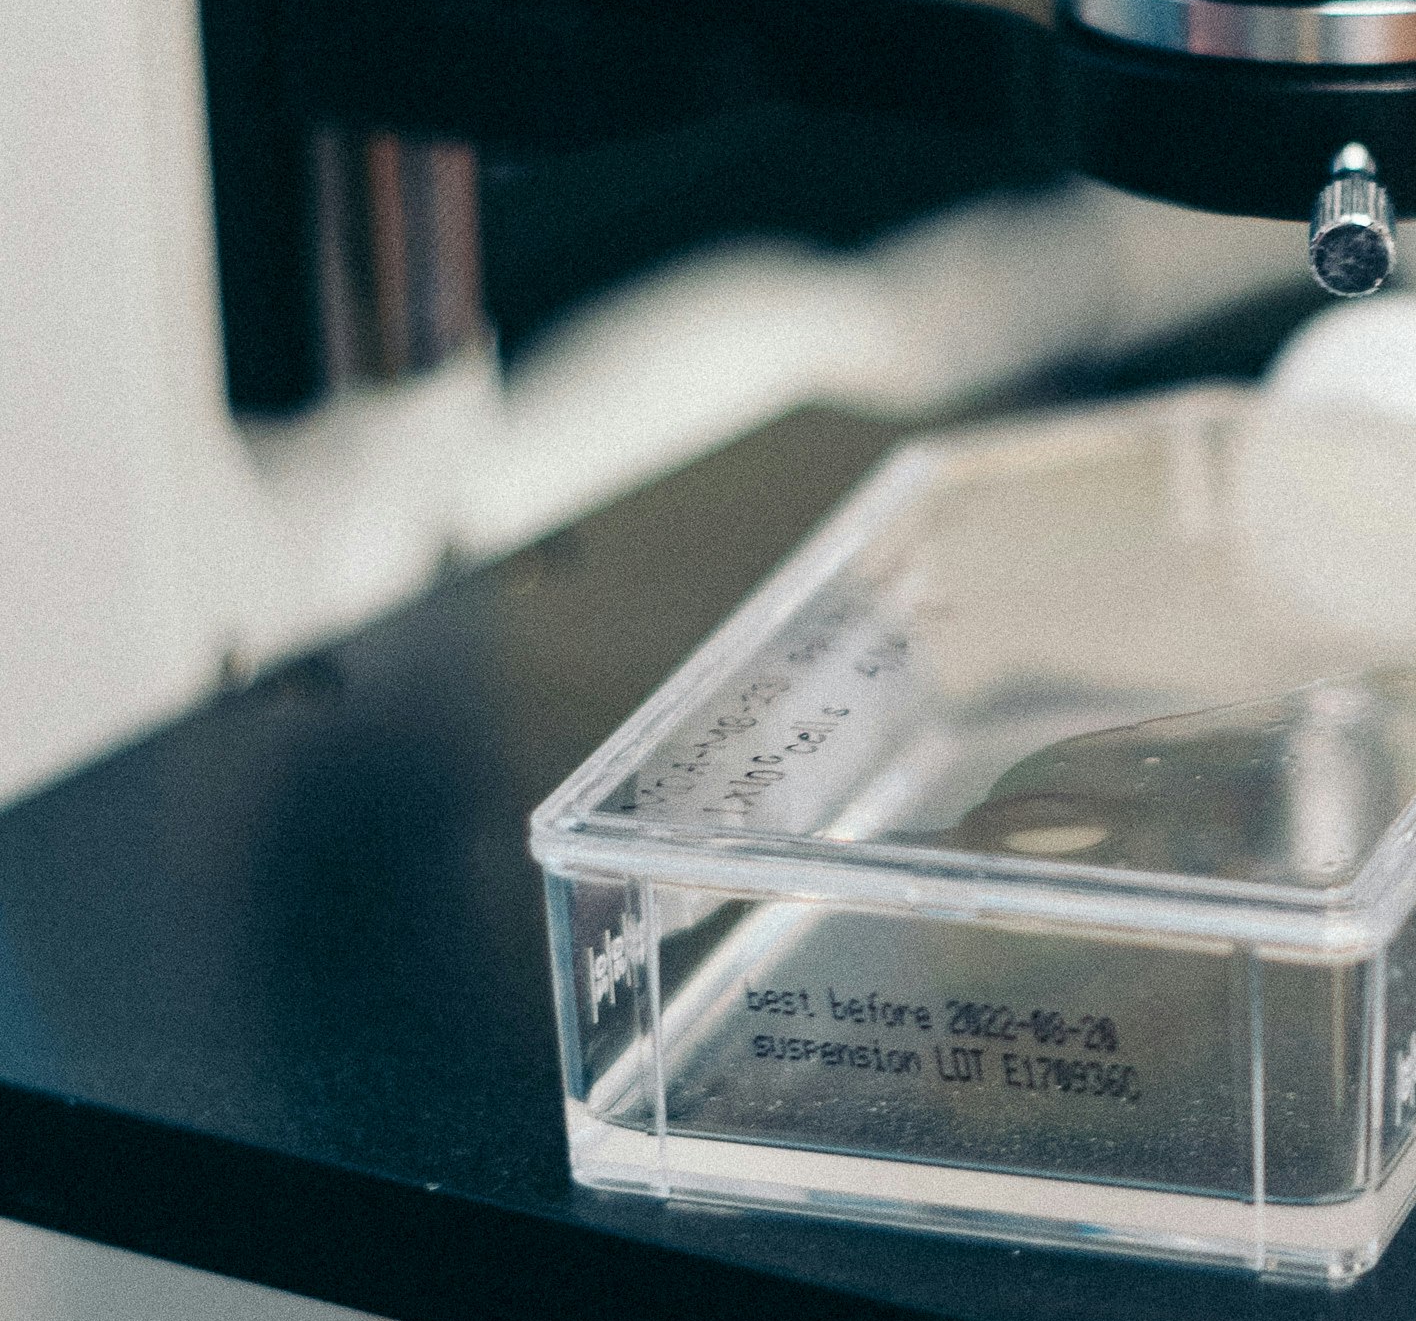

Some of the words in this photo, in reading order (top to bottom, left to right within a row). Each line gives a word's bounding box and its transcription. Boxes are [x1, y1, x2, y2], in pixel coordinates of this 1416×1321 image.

[785, 705, 851, 755] cells
[745, 982, 815, 1018] best
[828, 987, 932, 1031] before
[751, 1033, 921, 1075] suspension
[935, 1044, 986, 1084] LOT
